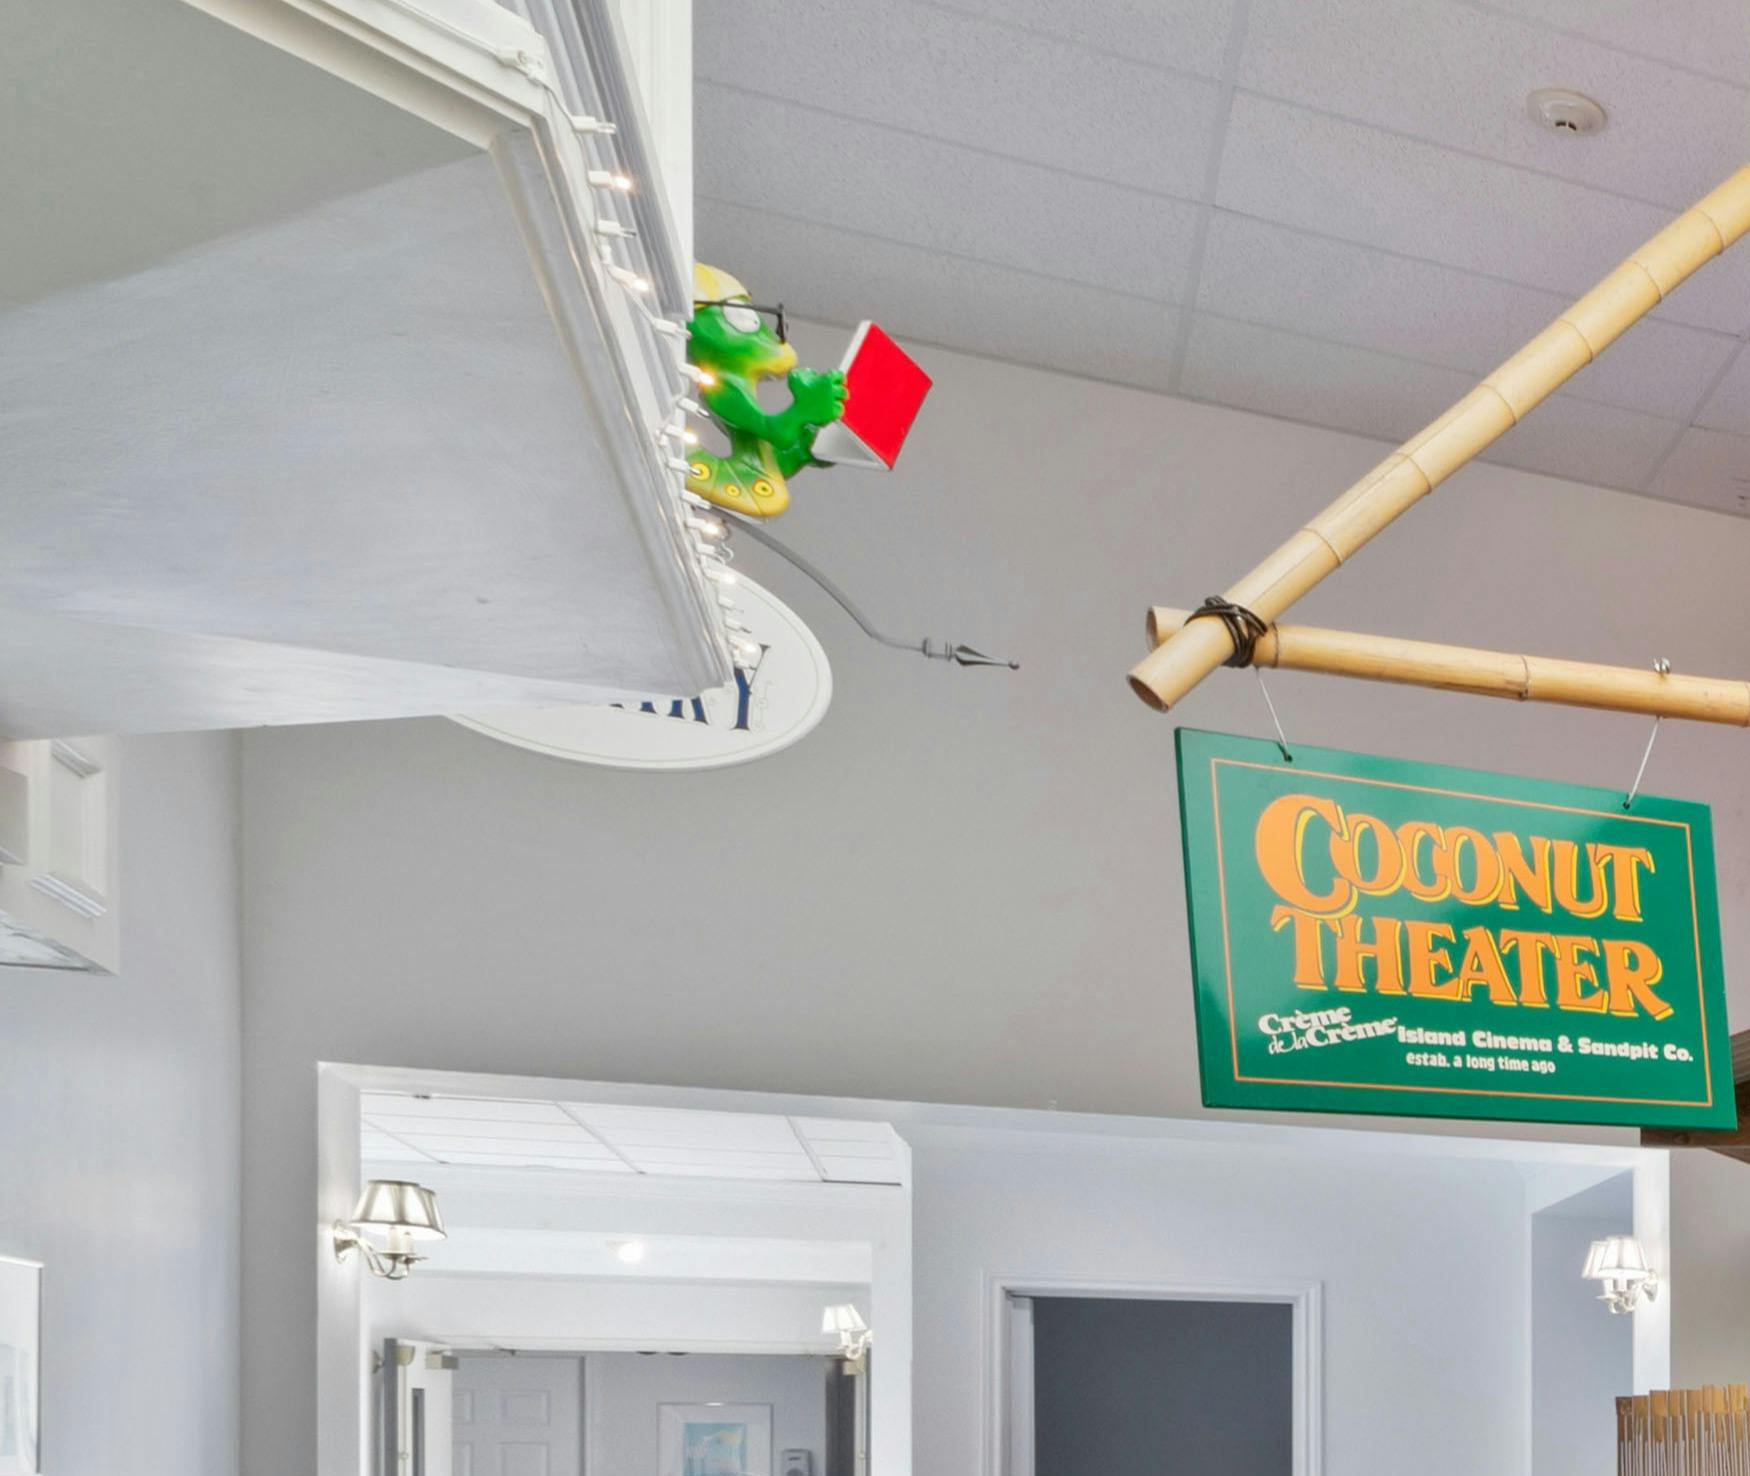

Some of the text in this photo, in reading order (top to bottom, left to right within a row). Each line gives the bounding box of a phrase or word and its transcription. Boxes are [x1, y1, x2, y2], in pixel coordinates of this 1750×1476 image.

[1255, 794, 1656, 922] COCONUT
[1270, 904, 1674, 1020] THEATER
[1258, 1006, 1352, 1035] Crème
[1305, 1017, 1397, 1047] Crème
[1397, 1025, 1694, 1062] Island Cinema & Sandpit Co.
[1406, 1052, 1556, 1075] estab. a long time ago
